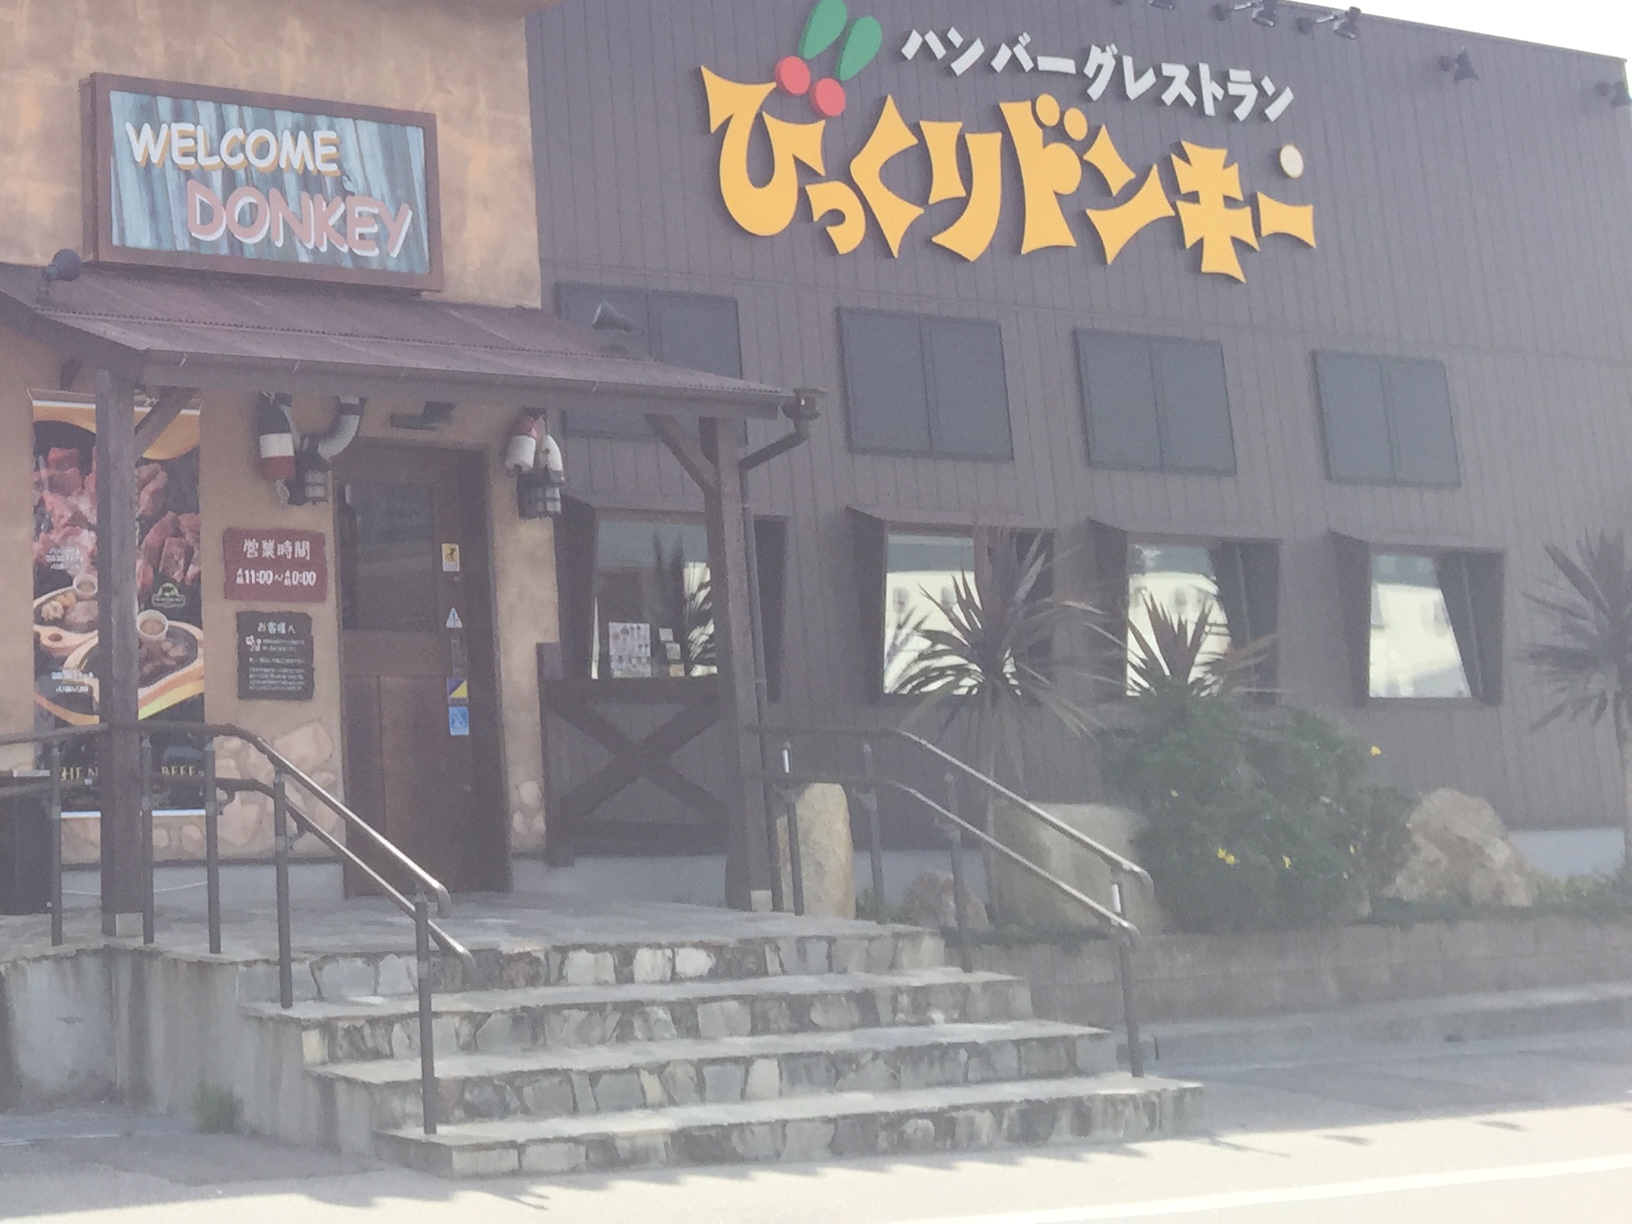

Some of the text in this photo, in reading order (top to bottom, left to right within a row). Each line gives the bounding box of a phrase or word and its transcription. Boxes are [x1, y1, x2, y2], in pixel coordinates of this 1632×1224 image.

[900, 26, 1294, 123] ハンバーグレストラン
[125, 121, 342, 177] WELCOME
[699, 55, 1317, 284] びっくりドンキー
[186, 179, 413, 258] DONKEY
[243, 538, 310, 560] 営業時間
